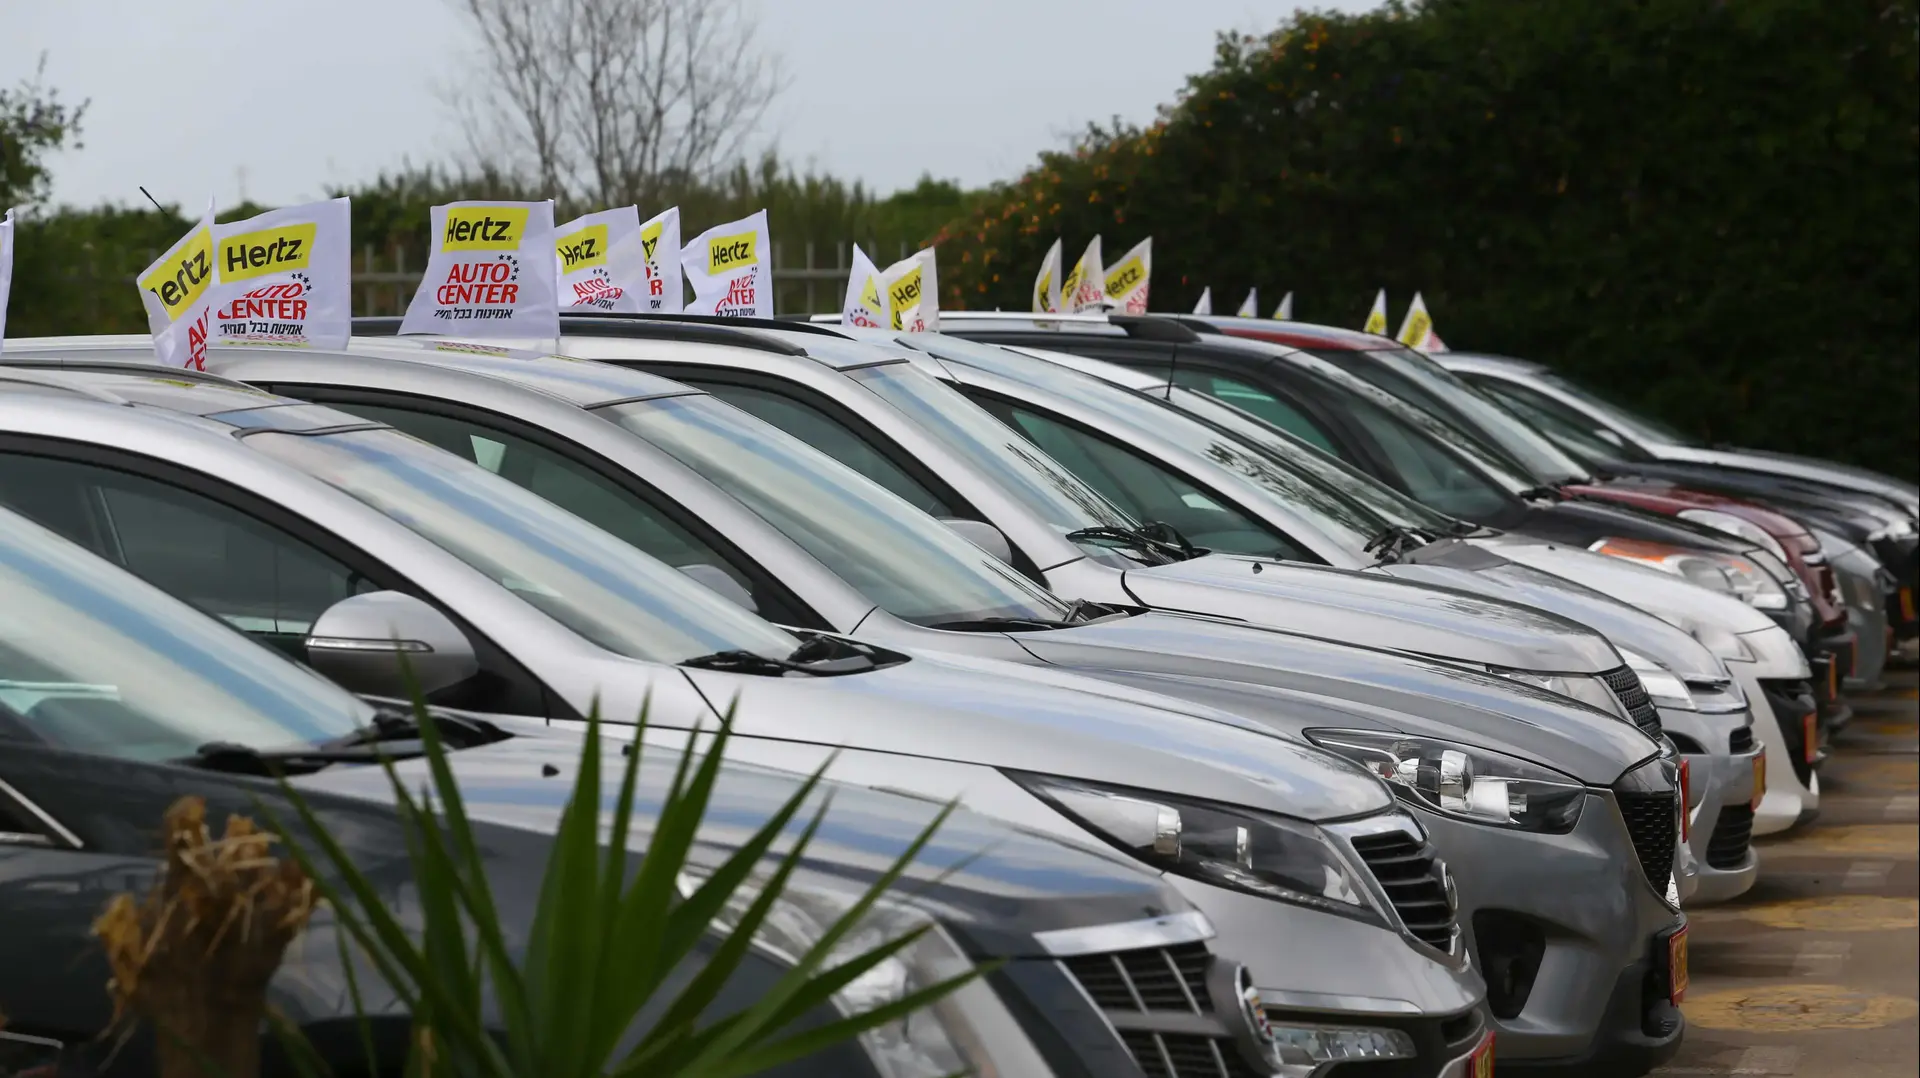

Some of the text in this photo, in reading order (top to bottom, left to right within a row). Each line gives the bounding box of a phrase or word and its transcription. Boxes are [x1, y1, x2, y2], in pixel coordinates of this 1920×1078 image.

[446, 216, 511, 243] Hertz
[227, 236, 303, 272] Hertz
[713, 241, 749, 267] Hertz
[446, 263, 510, 284] AUTO
[437, 284, 519, 305] CENTER
[573, 278, 609, 298] AUTO
[892, 274, 921, 305] Her
[454, 307, 472, 319] בכל
[474, 308, 513, 319] אמינות
[220, 320, 303, 335] אמינות בכל מחיר
